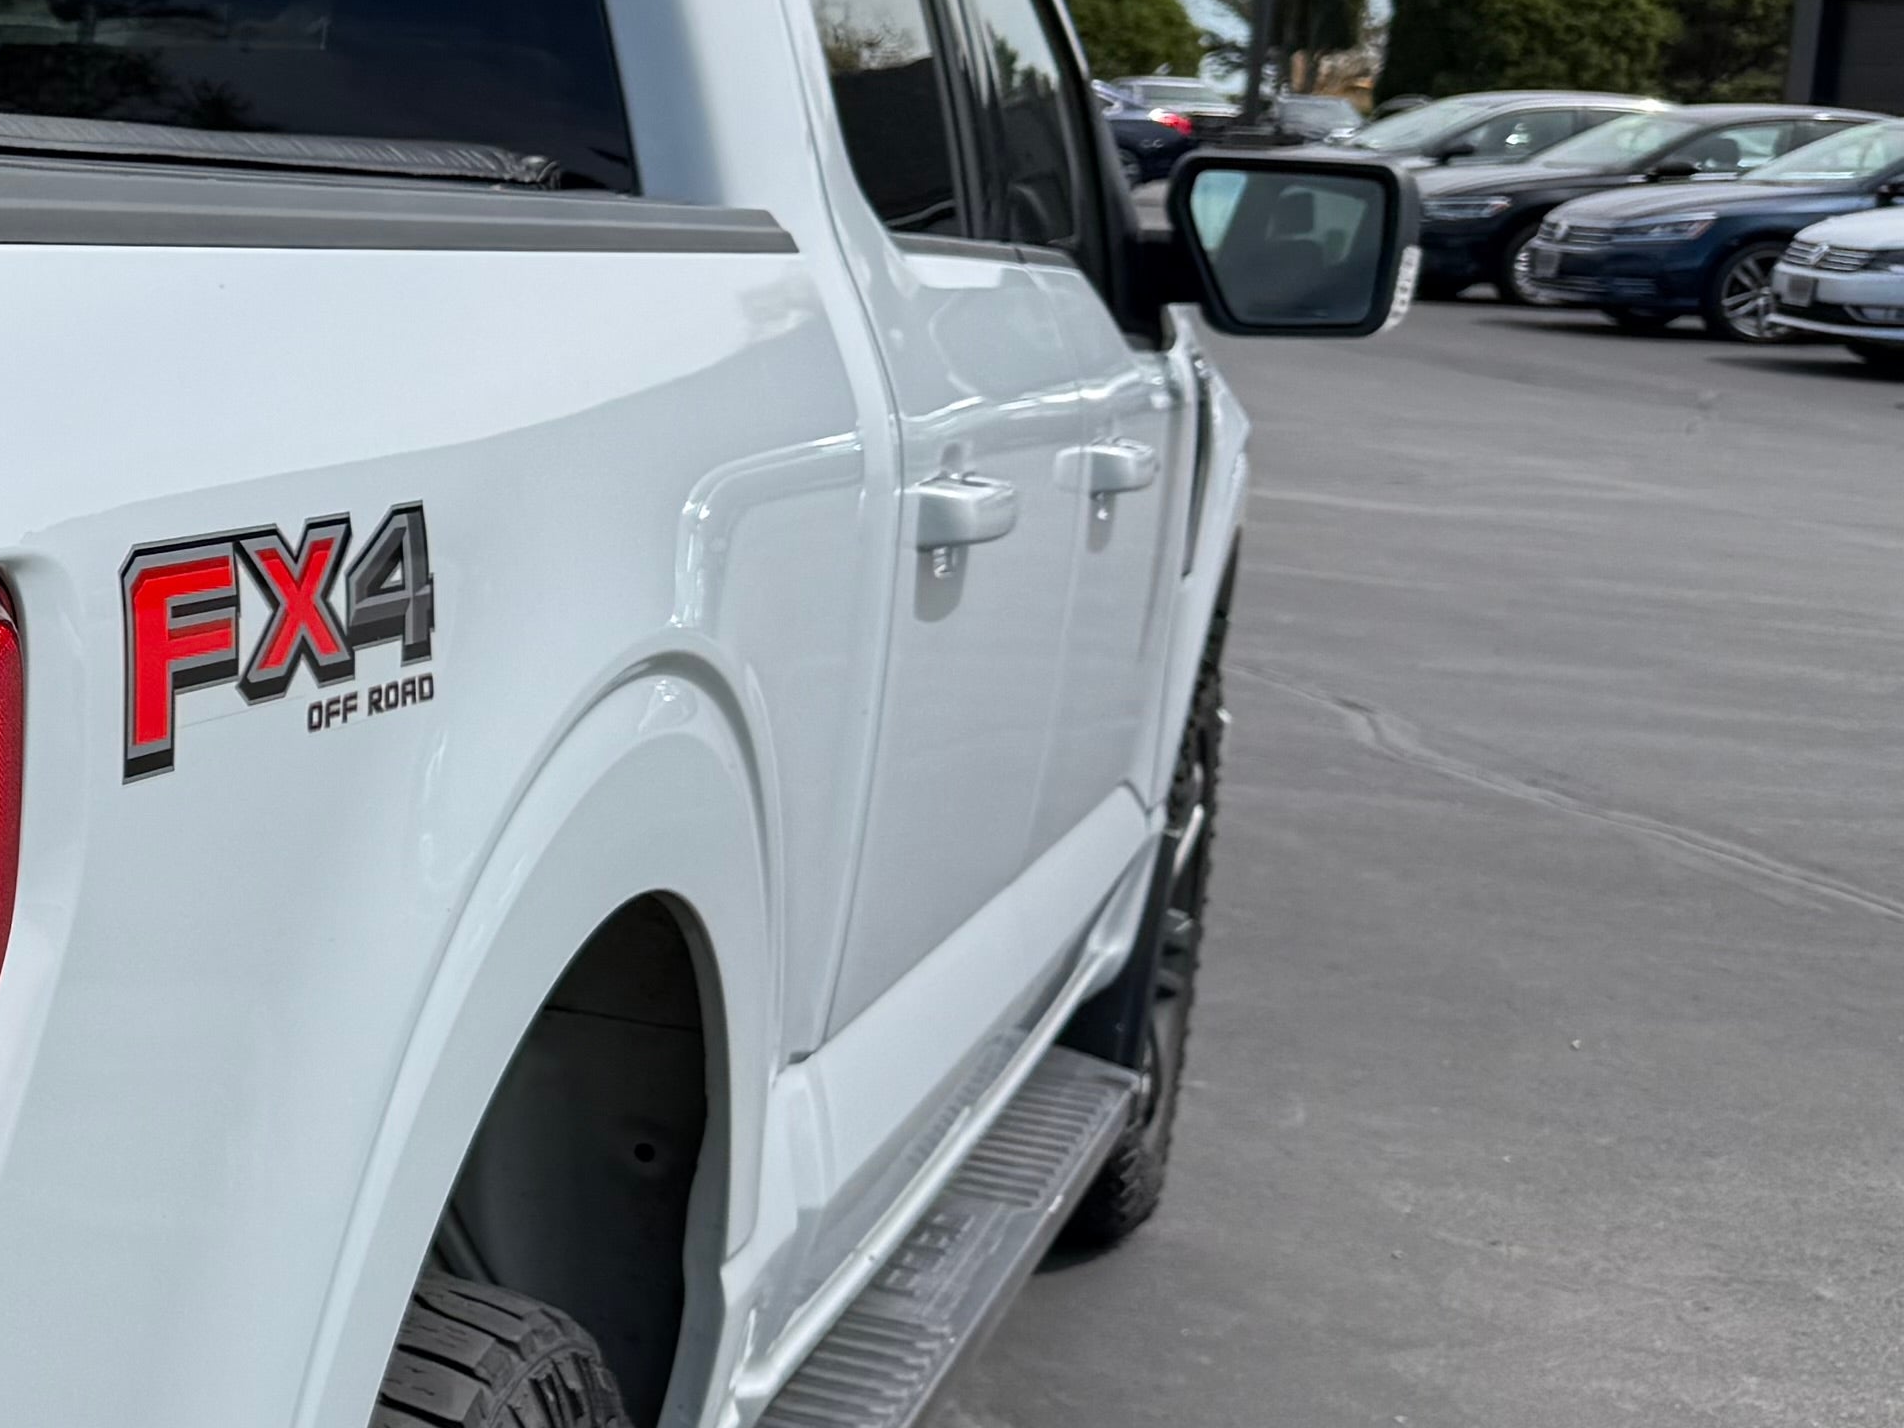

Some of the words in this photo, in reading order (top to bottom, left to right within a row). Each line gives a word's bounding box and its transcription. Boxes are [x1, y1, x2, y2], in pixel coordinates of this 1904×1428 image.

[118, 500, 435, 785] FX4
[307, 691, 358, 734] OFF
[367, 672, 435, 717] ROAD
